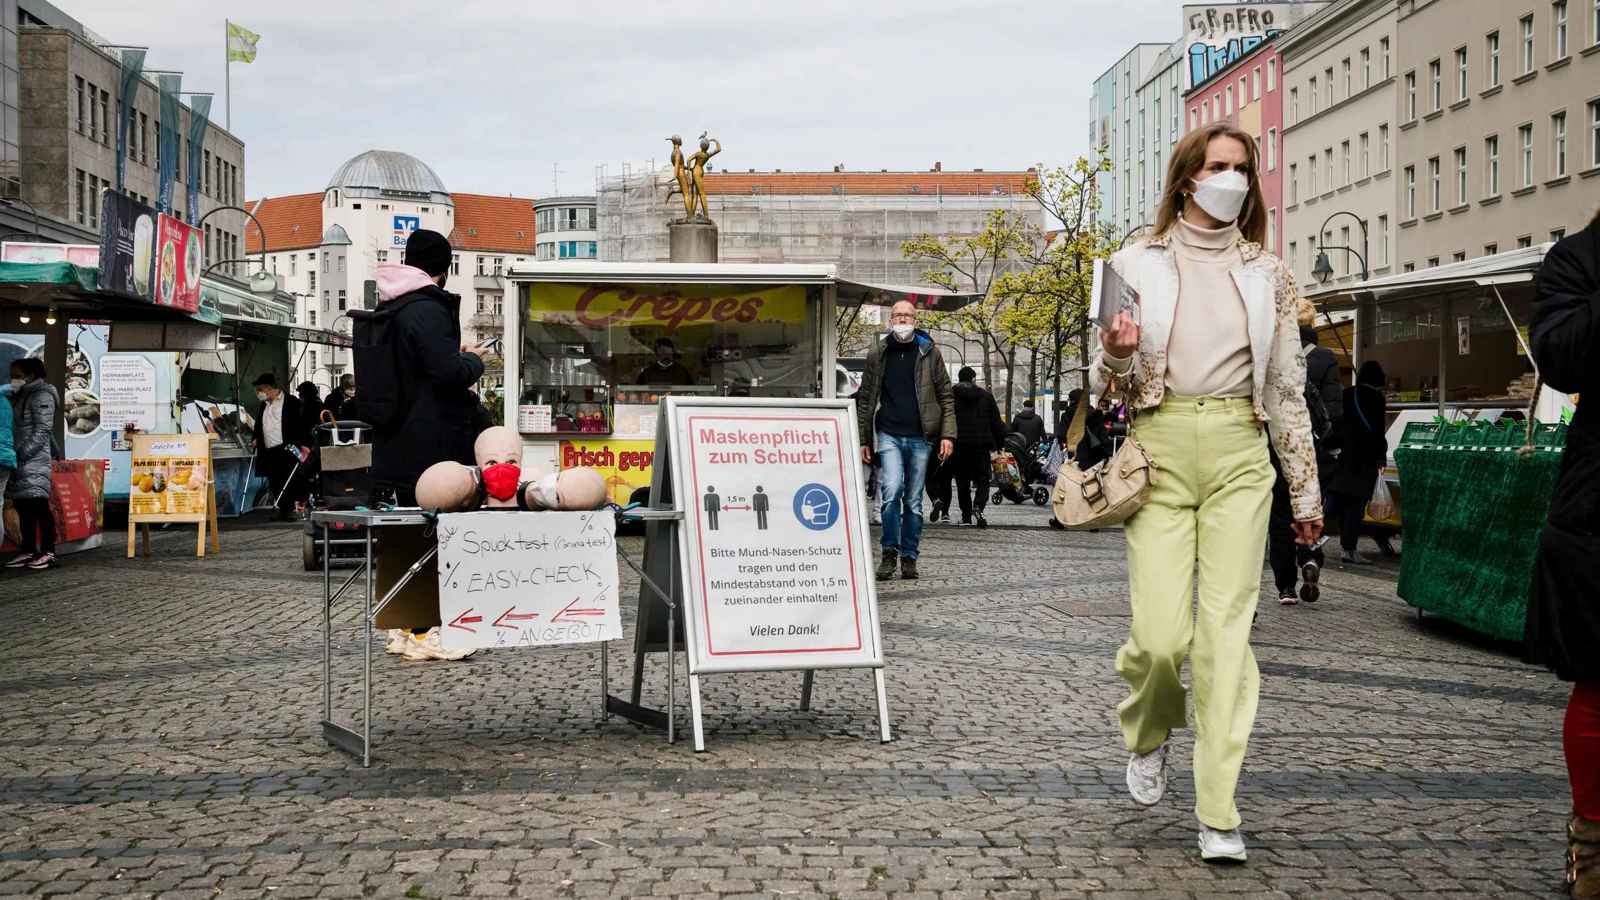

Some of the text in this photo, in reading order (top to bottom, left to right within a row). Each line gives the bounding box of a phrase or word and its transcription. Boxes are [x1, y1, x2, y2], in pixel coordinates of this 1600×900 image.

[700, 429, 831, 447] Maskenpflicht
[563, 445, 615, 467] Frisch
[709, 449, 823, 464] zum Schutz!
[727, 495, 738, 504] 1,5
[711, 546, 843, 558] Bitte Mund-Nasen-Schutz
[738, 562, 818, 574] tragen und den
[467, 562, 601, 593] EASY-CHECK
[711, 577, 848, 590] Mindestabstand von 1,5 m
[724, 592, 839, 606] zueinander einhalten!
[518, 623, 607, 643] ANGEBOT
[750, 623, 820, 637] Vielen Dank!
